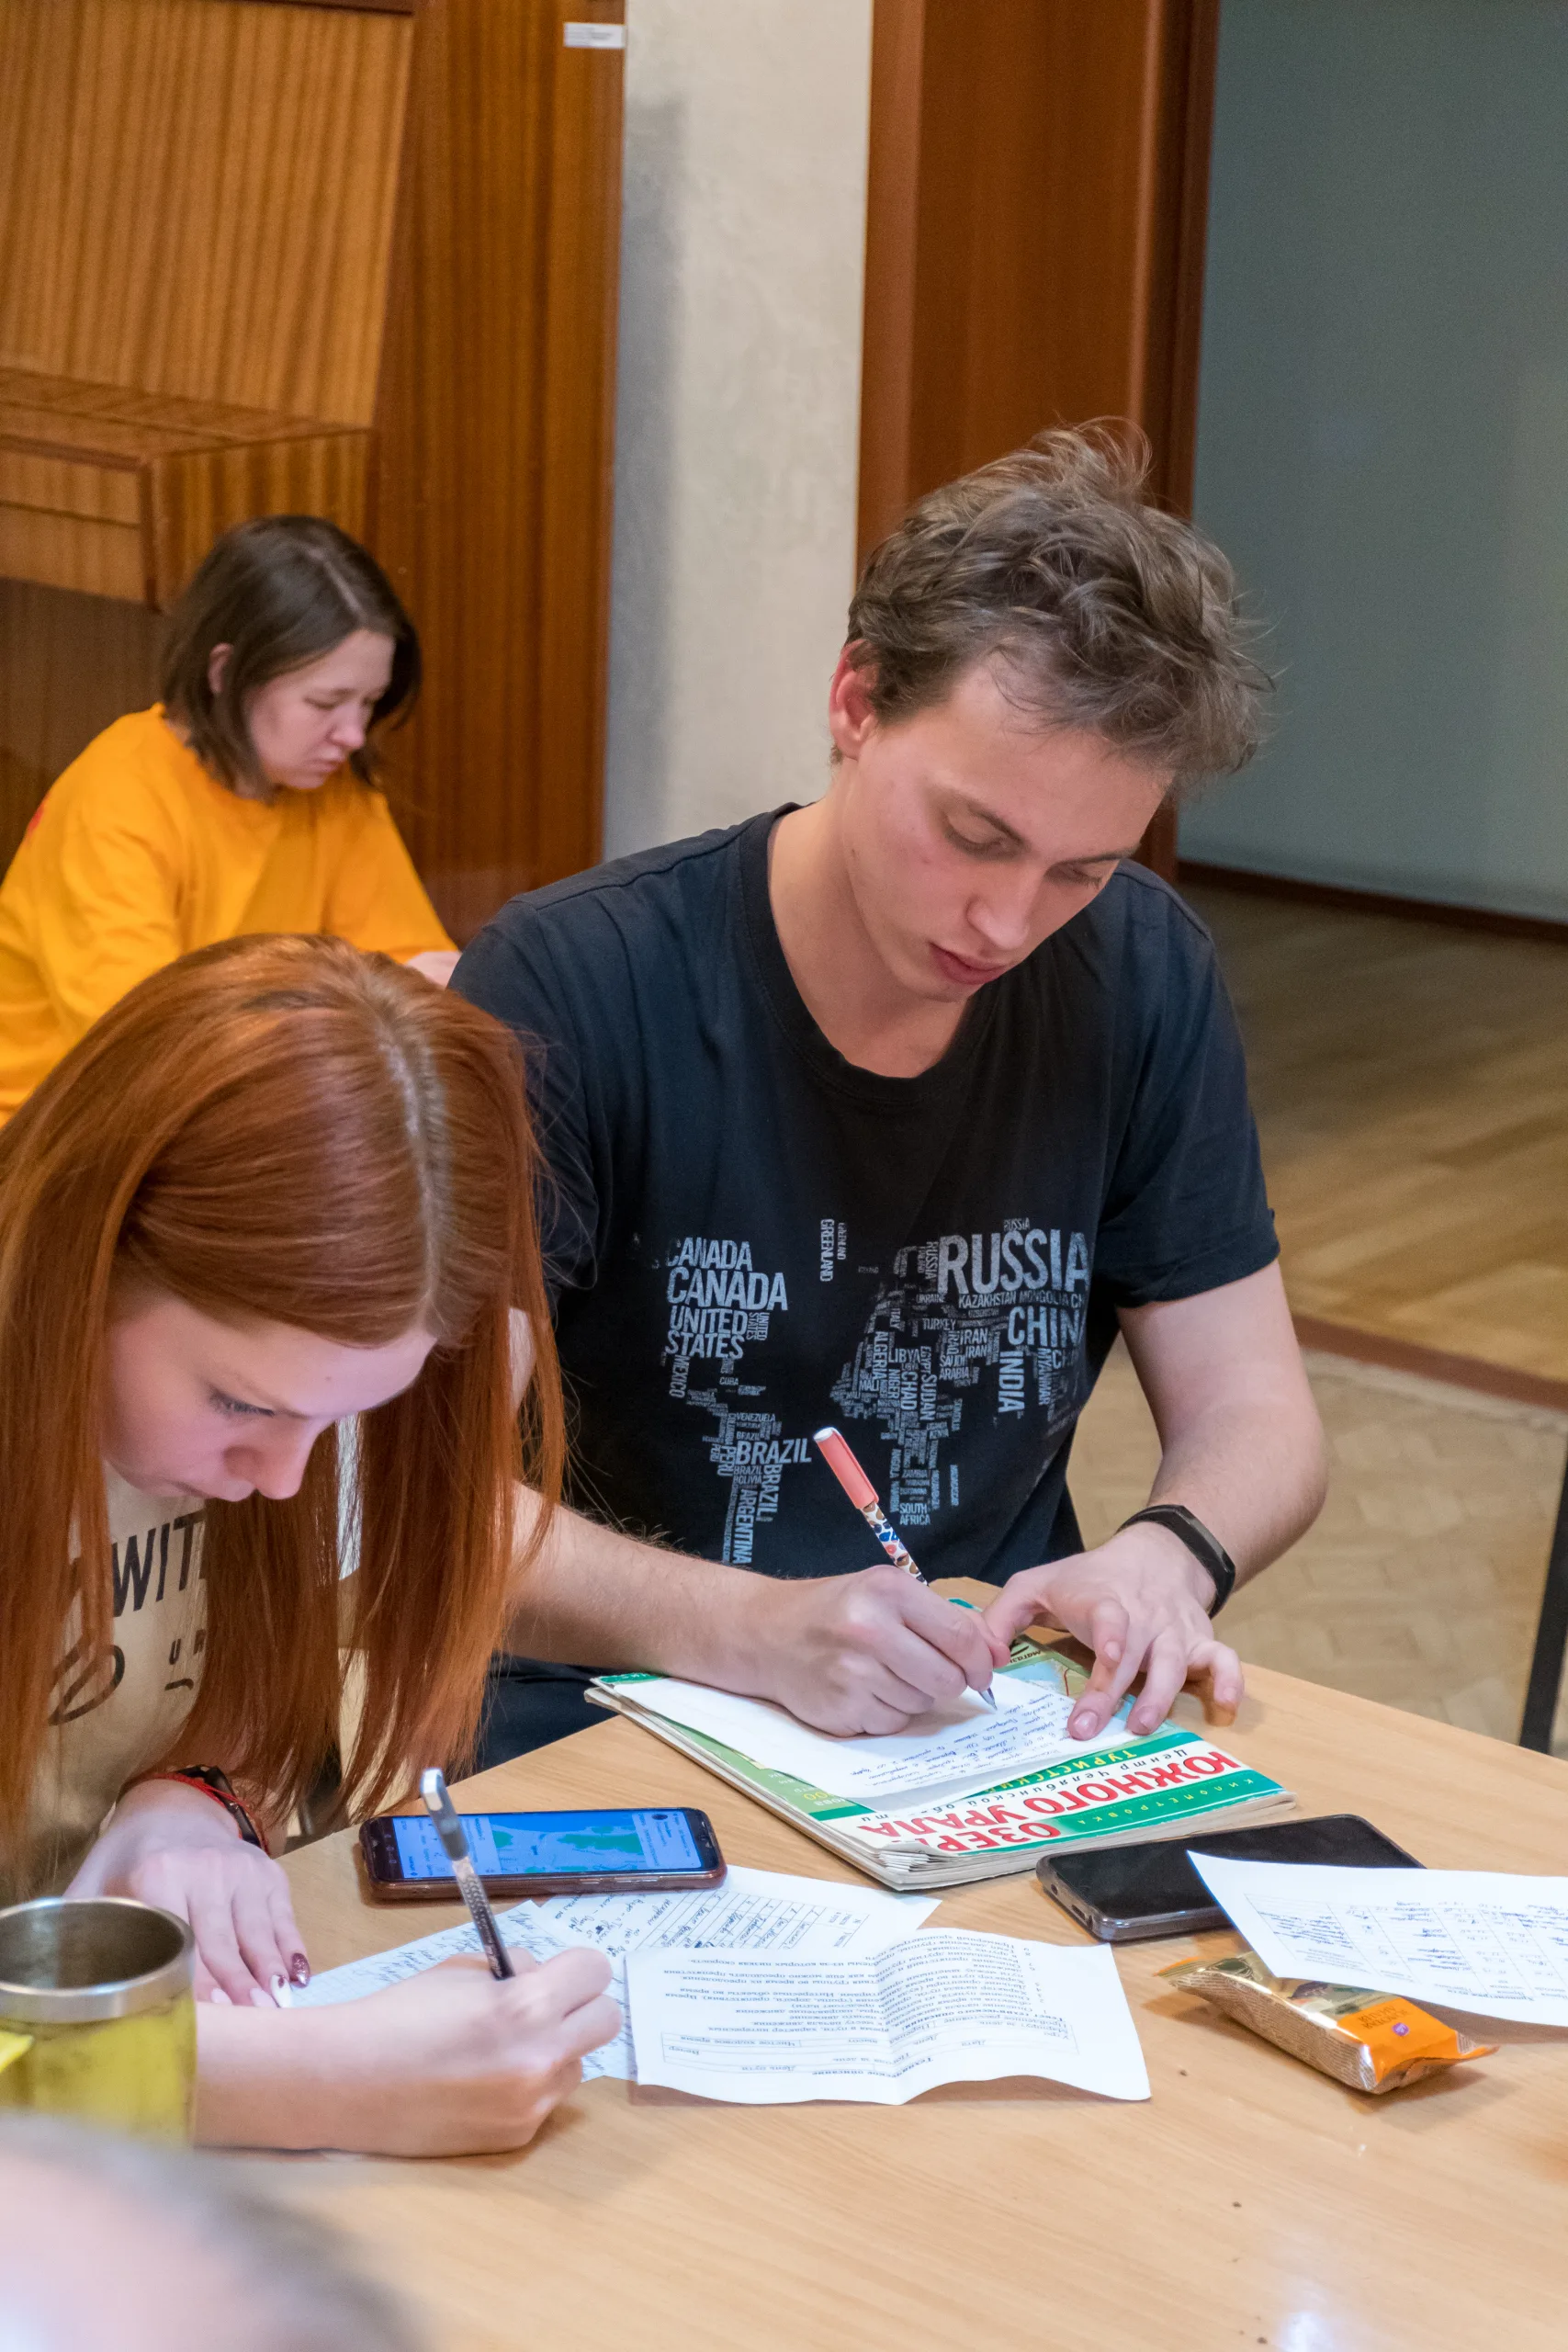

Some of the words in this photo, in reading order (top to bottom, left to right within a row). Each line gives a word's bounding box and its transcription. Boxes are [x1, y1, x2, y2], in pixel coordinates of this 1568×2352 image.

[820, 1219, 835, 1282] GREENLAND
[925, 1241, 939, 1280] RUSSIA
[937, 1228, 1091, 1295] RUSSIA
[667, 1267, 788, 1311] CANADA
[958, 1290, 1017, 1309] KAZAKHSTAN
[1019, 1291, 1069, 1306] MONGOLIA
[671, 1306, 748, 1336] UNITED
[746, 1312, 759, 1340] STATES
[757, 1312, 771, 1340] UNITED
[922, 1317, 956, 1330] TURKEY
[1008, 1306, 1083, 1348] CHIN
[665, 1329, 745, 1360] STATES
[947, 1330, 960, 1355] IRAQ
[960, 1328, 988, 1345] IRAN
[873, 1331, 888, 1380] ALGERIA
[888, 1348, 920, 1363] LIBYA
[920, 1346, 931, 1374] EGYPT
[940, 1354, 965, 1367] SAUDI
[965, 1344, 987, 1359] IRAN
[669, 1354, 691, 1397] MEXICO
[859, 1379, 879, 1392] MALI
[887, 1369, 900, 1399] NIGER
[939, 1366, 969, 1380] ARABIA
[998, 1351, 1025, 1413] INDIA
[1037, 1348, 1053, 1406] MYANMAR
[900, 1371, 919, 1410] CHAD
[919, 1374, 937, 1421] SUDAN
[736, 1412, 776, 1422] VENEZUELA
[716, 1445, 737, 1477] PERU
[735, 1438, 812, 1465] BRAZIL
[733, 1475, 761, 1485] BOLIVIA
[734, 1465, 762, 1476] BRAZIL
[756, 1464, 783, 1514] BRAZIL
[900, 1503, 928, 1514] SOUTH
[900, 1513, 931, 1525] AFRICA
[732, 1488, 758, 1564] ARGENTINA
[1022, 1751, 1241, 1815] ЮЖНОГО
[861, 1804, 955, 1823] обти
[1077, 1778, 1254, 1826] КИЛОМЕТРОВКА
[856, 1804, 1028, 1838] УРАЛА
[867, 2057, 932, 2078] Техническое
